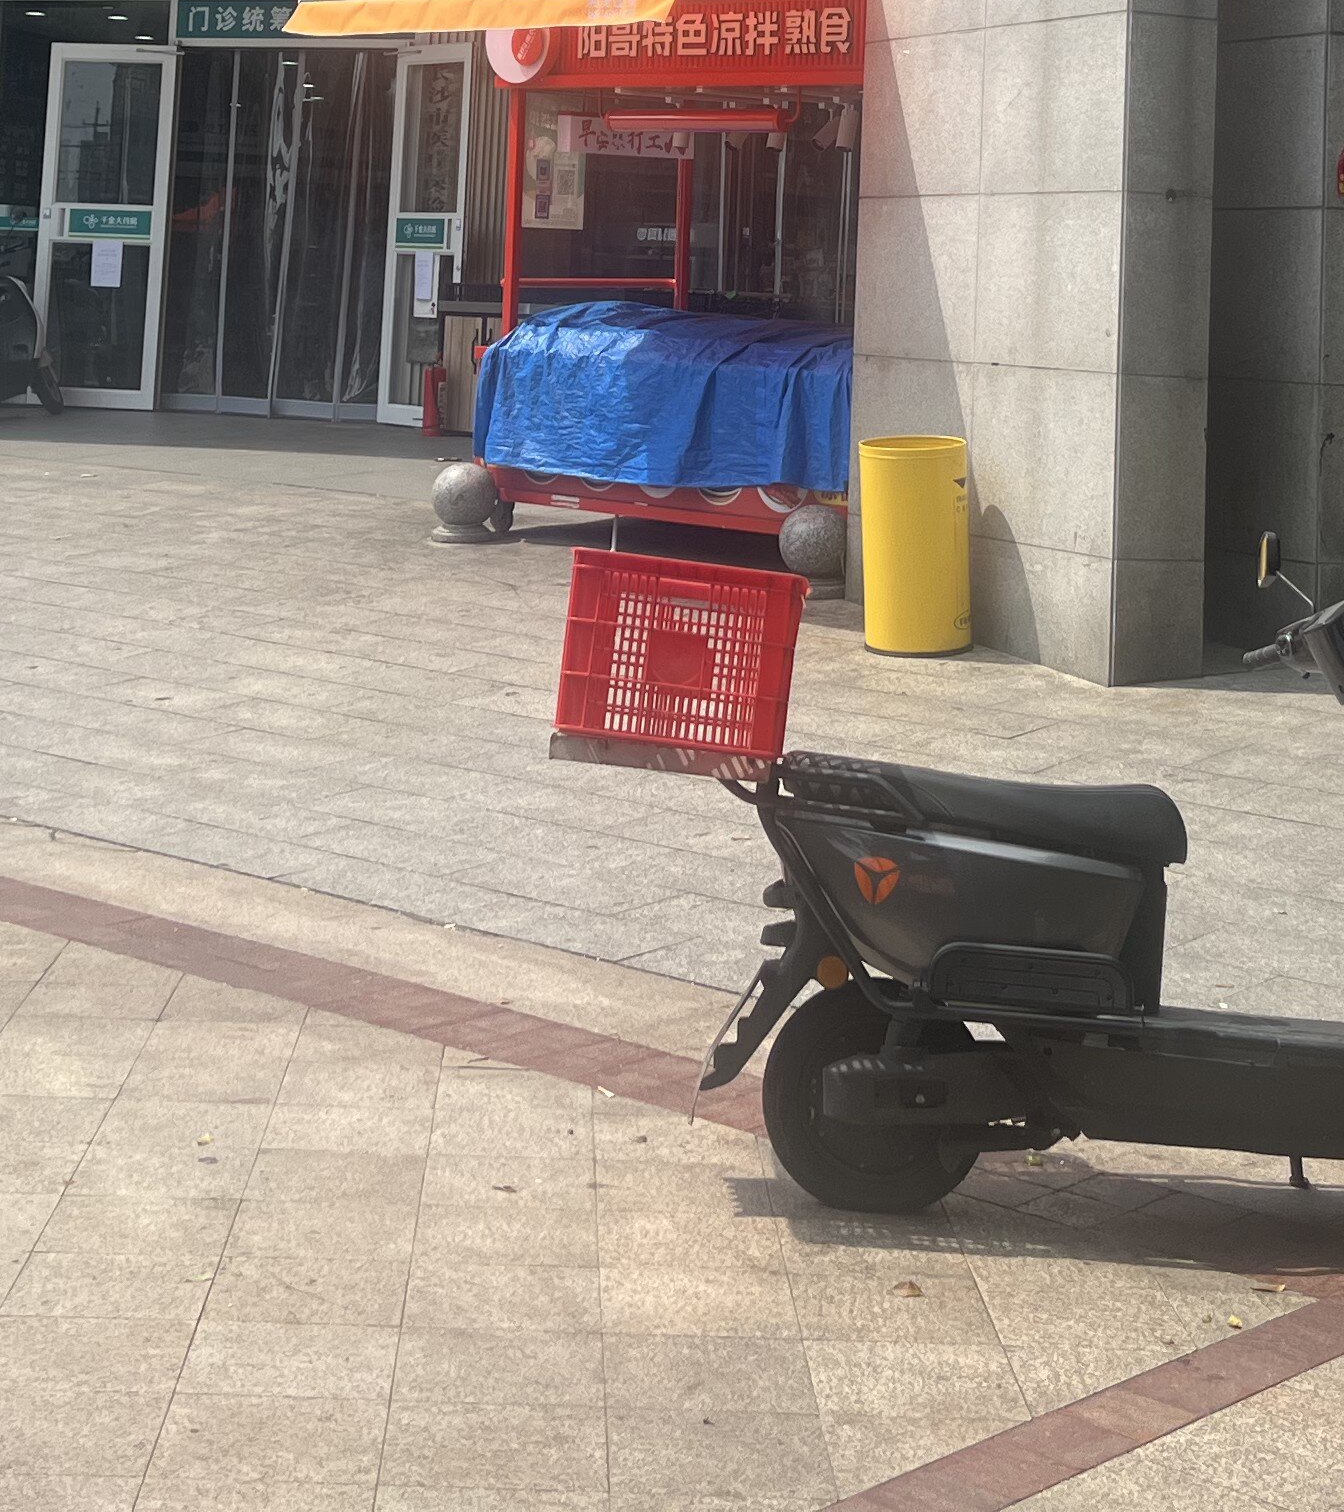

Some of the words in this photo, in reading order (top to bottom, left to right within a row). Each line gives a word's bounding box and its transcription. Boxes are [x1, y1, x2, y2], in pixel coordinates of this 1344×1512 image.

[577, 6, 853, 59] 阳哥特色凉拌熟食
